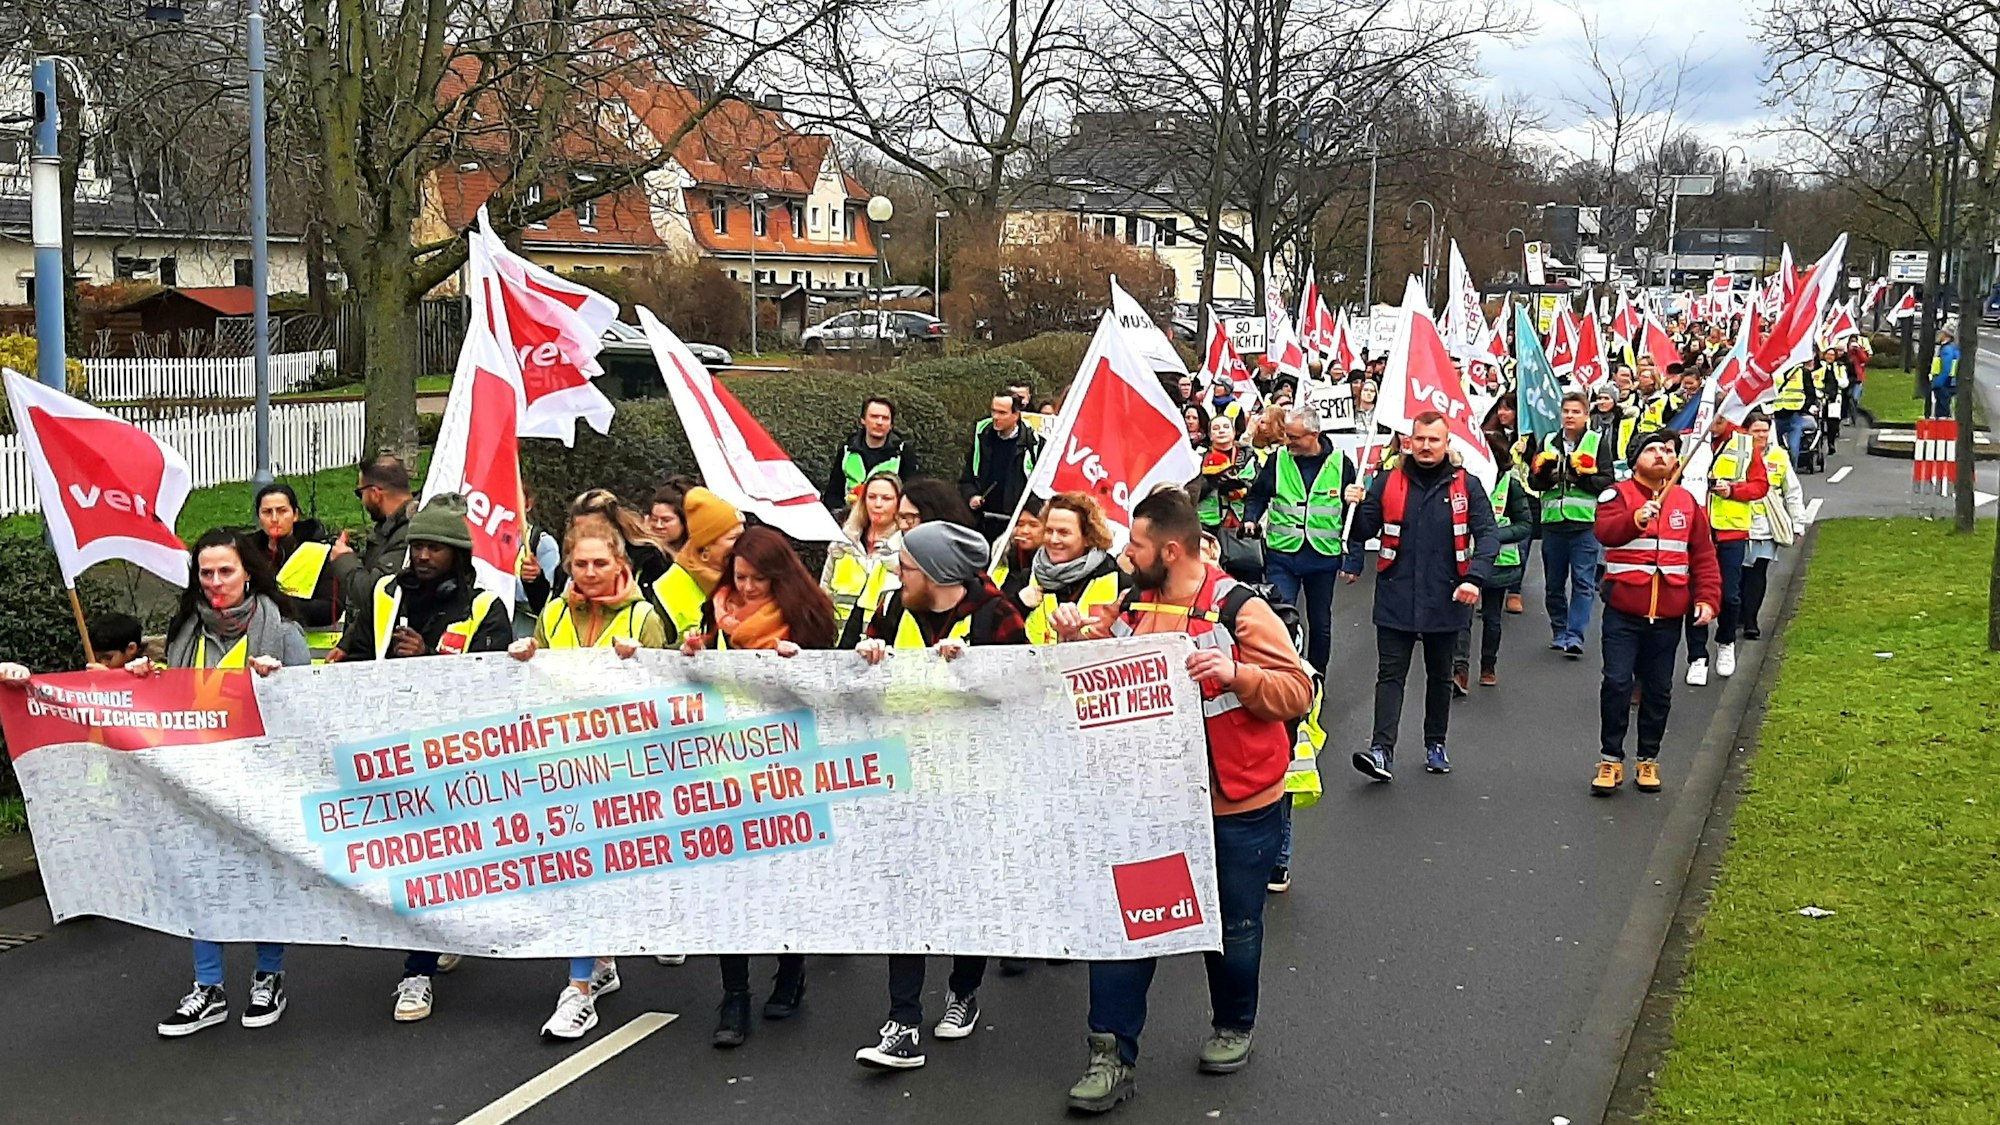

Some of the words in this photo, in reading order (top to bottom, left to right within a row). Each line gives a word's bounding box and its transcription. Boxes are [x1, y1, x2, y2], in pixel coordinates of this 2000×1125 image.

[1235, 321, 1250, 334] SO
[1066, 655, 1168, 695] ZUSAMMEN
[1077, 692, 1120, 720] GEHT
[1127, 684, 1173, 712] MEHR
[27, 697, 159, 728] ÖFFENTLICHER
[160, 710, 229, 729] DIENST
[354, 745, 414, 781] DIE
[424, 701, 658, 768] BESCHÄFTIGTEN
[668, 692, 705, 725] IM
[319, 786, 434, 832] BEZIRK
[446, 722, 801, 810] KÖLN-BONN-LEVERKUSEN
[348, 822, 482, 872] FORDERN
[493, 803, 586, 846] 10,5%
[593, 791, 662, 828] MEHR
[674, 778, 741, 815] GELD
[751, 764, 803, 802] FÜR
[816, 754, 894, 792] ALLE,
[406, 848, 593, 908] MINDESTENS
[605, 835, 672, 873] ABER
[681, 825, 733, 860] 500
[743, 812, 825, 850] EURO.
